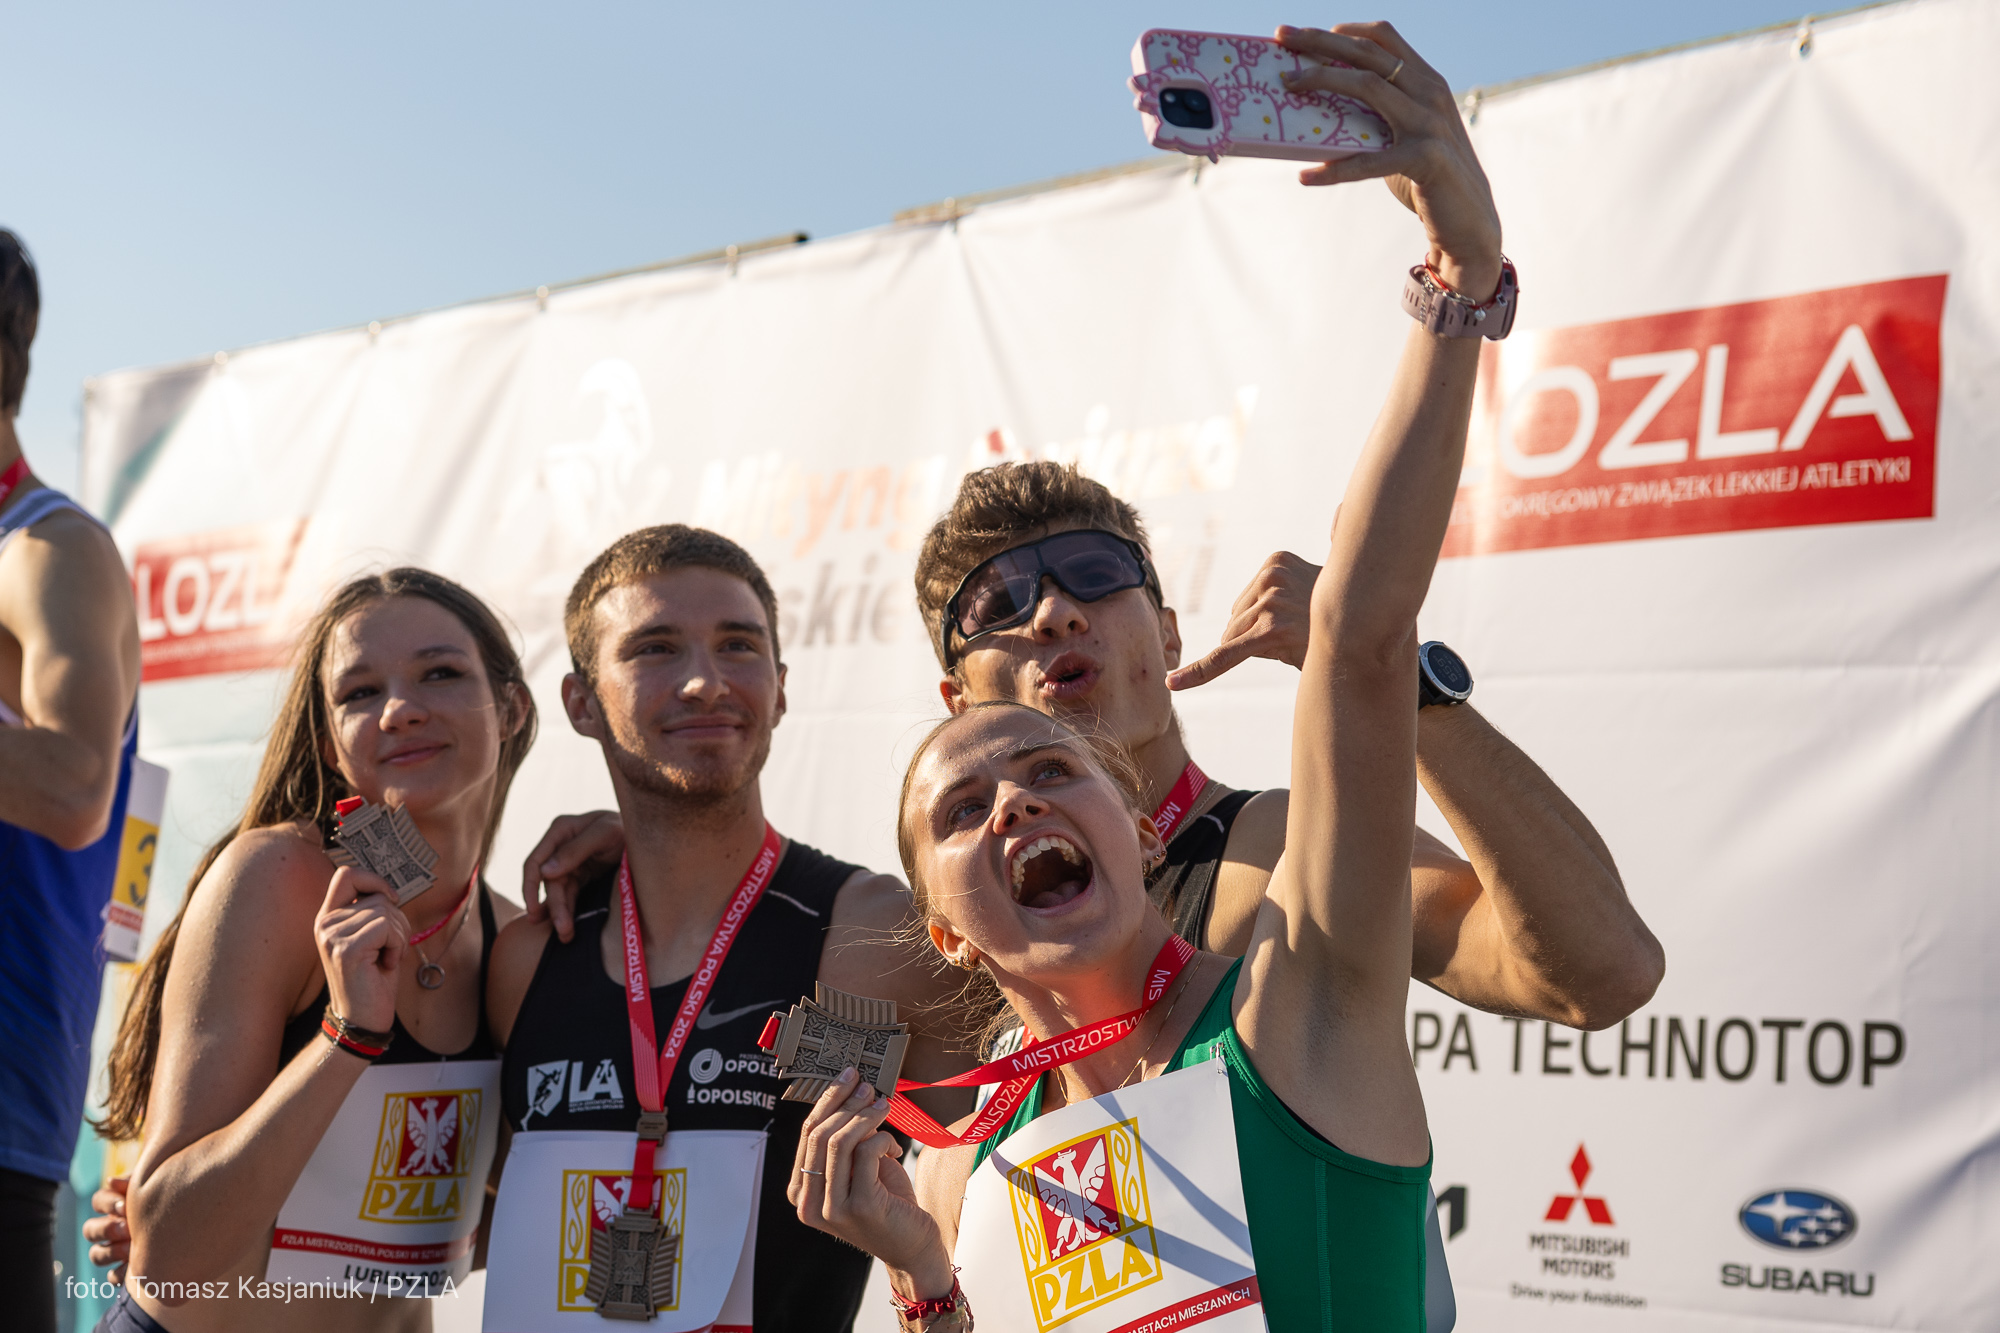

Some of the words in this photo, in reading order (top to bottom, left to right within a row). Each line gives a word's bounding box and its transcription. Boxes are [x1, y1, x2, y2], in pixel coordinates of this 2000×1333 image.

[1460, 324, 1914, 488] OZLA
[1713, 465, 1799, 498] LEKKIEJ
[1800, 456, 1911, 491] ATLETYKI
[138, 555, 273, 641] LOZL
[709, 846, 775, 955] MISTRZOSTWA
[682, 957, 717, 1017] POLSKI
[664, 1017, 691, 1059] 2024
[1413, 1012, 1479, 1072] PA
[1502, 1013, 1908, 1087] TECHNOTOP
[724, 1059, 778, 1078] OPOLE
[697, 1088, 777, 1111] OPOLSKIE
[967, 1075, 1032, 1138] TRZOSTWA
[368, 1180, 462, 1218] PZLA
[281, 1234, 304, 1246] PZLA
[306, 1236, 376, 1257] MISTRZOSTWA
[377, 1247, 409, 1260] POLSKI
[1530, 1232, 1630, 1257] MITSUBISHI
[344, 1264, 416, 1288] LUBLIN
[1035, 1236, 1153, 1322] PZLA
[1542, 1257, 1615, 1280] MOTORS
[1720, 1262, 1876, 1298] SUBARU
[1178, 1286, 1251, 1322] MIESZANYCH
